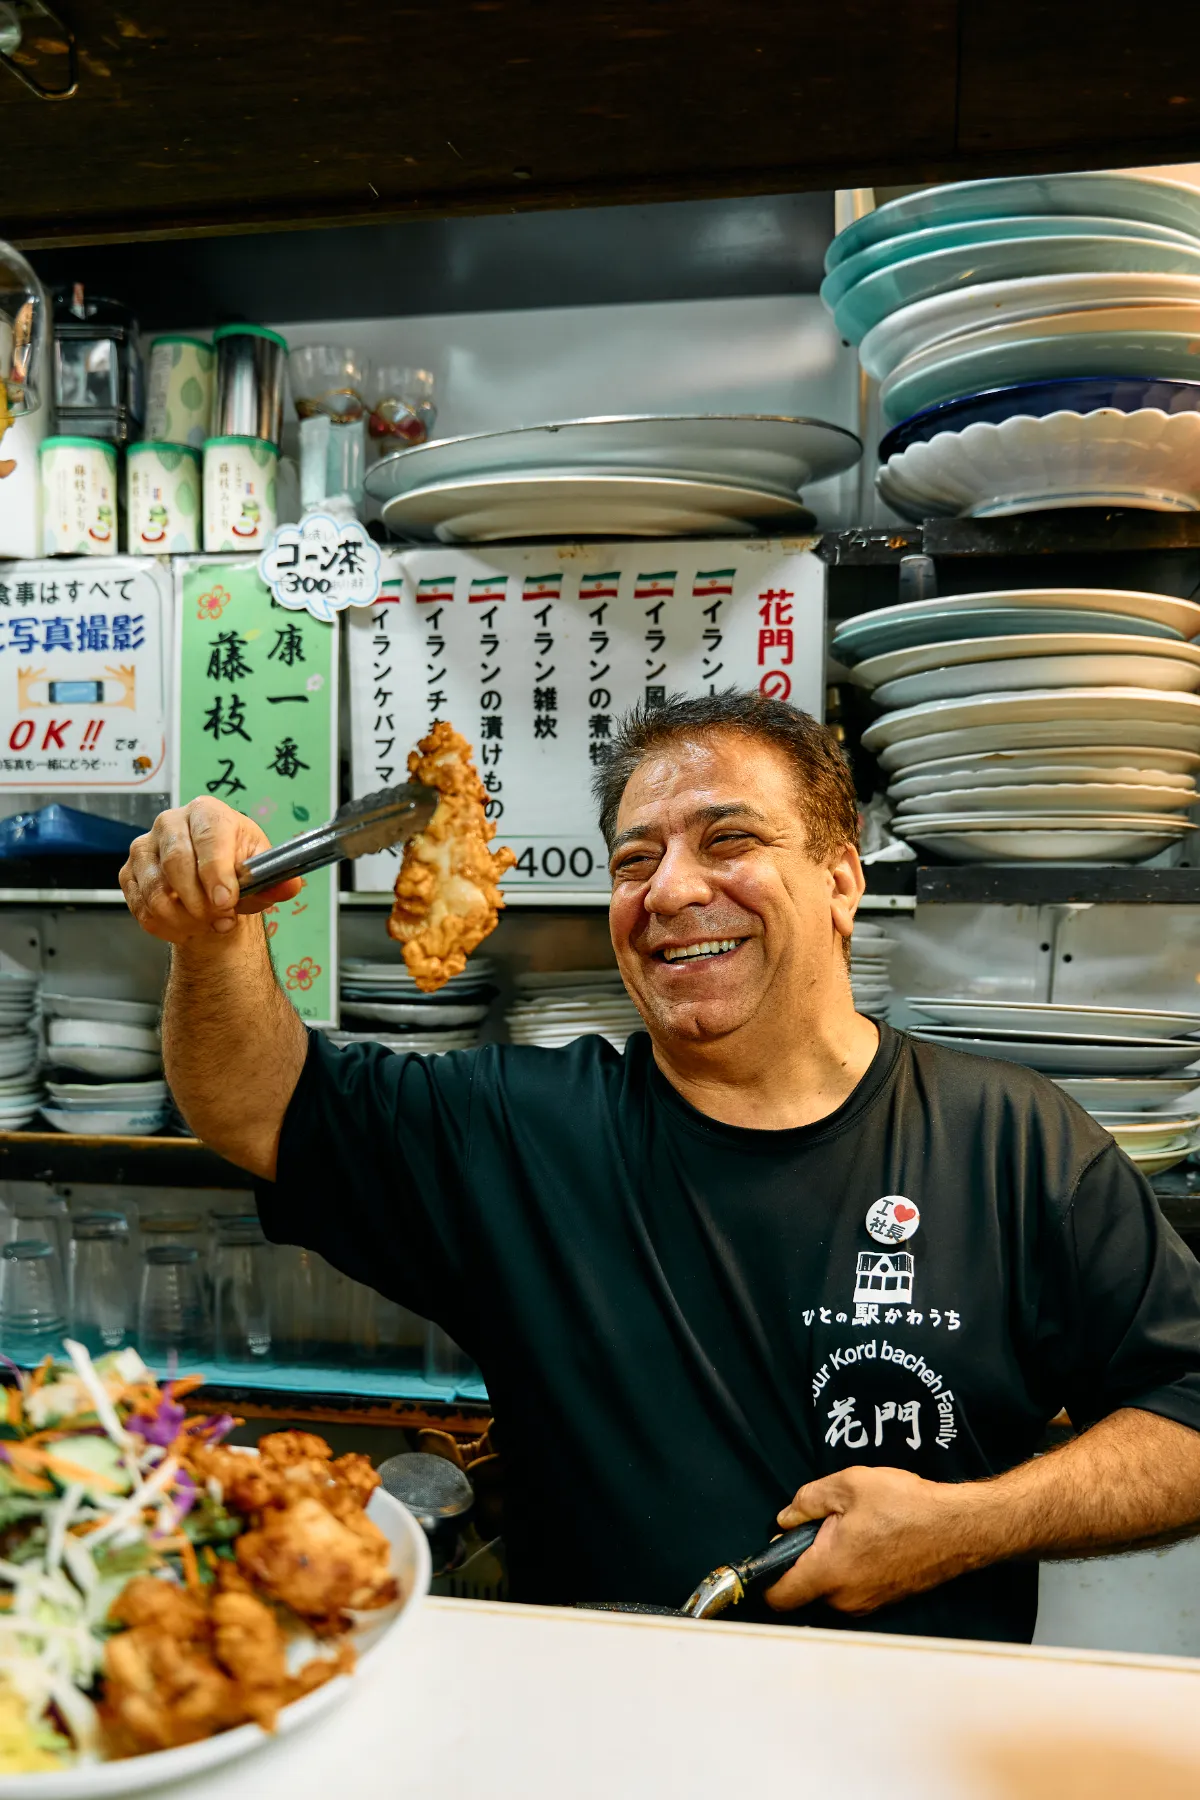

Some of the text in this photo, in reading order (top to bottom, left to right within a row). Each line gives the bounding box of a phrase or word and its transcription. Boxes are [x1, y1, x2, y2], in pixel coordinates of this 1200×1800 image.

[277, 540, 366, 575] コーン茶
[0, 614, 145, 654] 写真撮影
[533, 604, 557, 739] イラン雑炊
[757, 589, 795, 701] 花門の
[266, 586, 311, 780] 康一番
[480, 606, 504, 819] イランの漬けもの
[869, 1216, 906, 1243] 社長
[802, 1302, 961, 1331] ひとの駅かわうち
[824, 1396, 922, 1451] 花門
[829, 1339, 877, 1371] Kord
[880, 1340, 943, 1393] bacheh
[934, 1389, 958, 1450] Family
